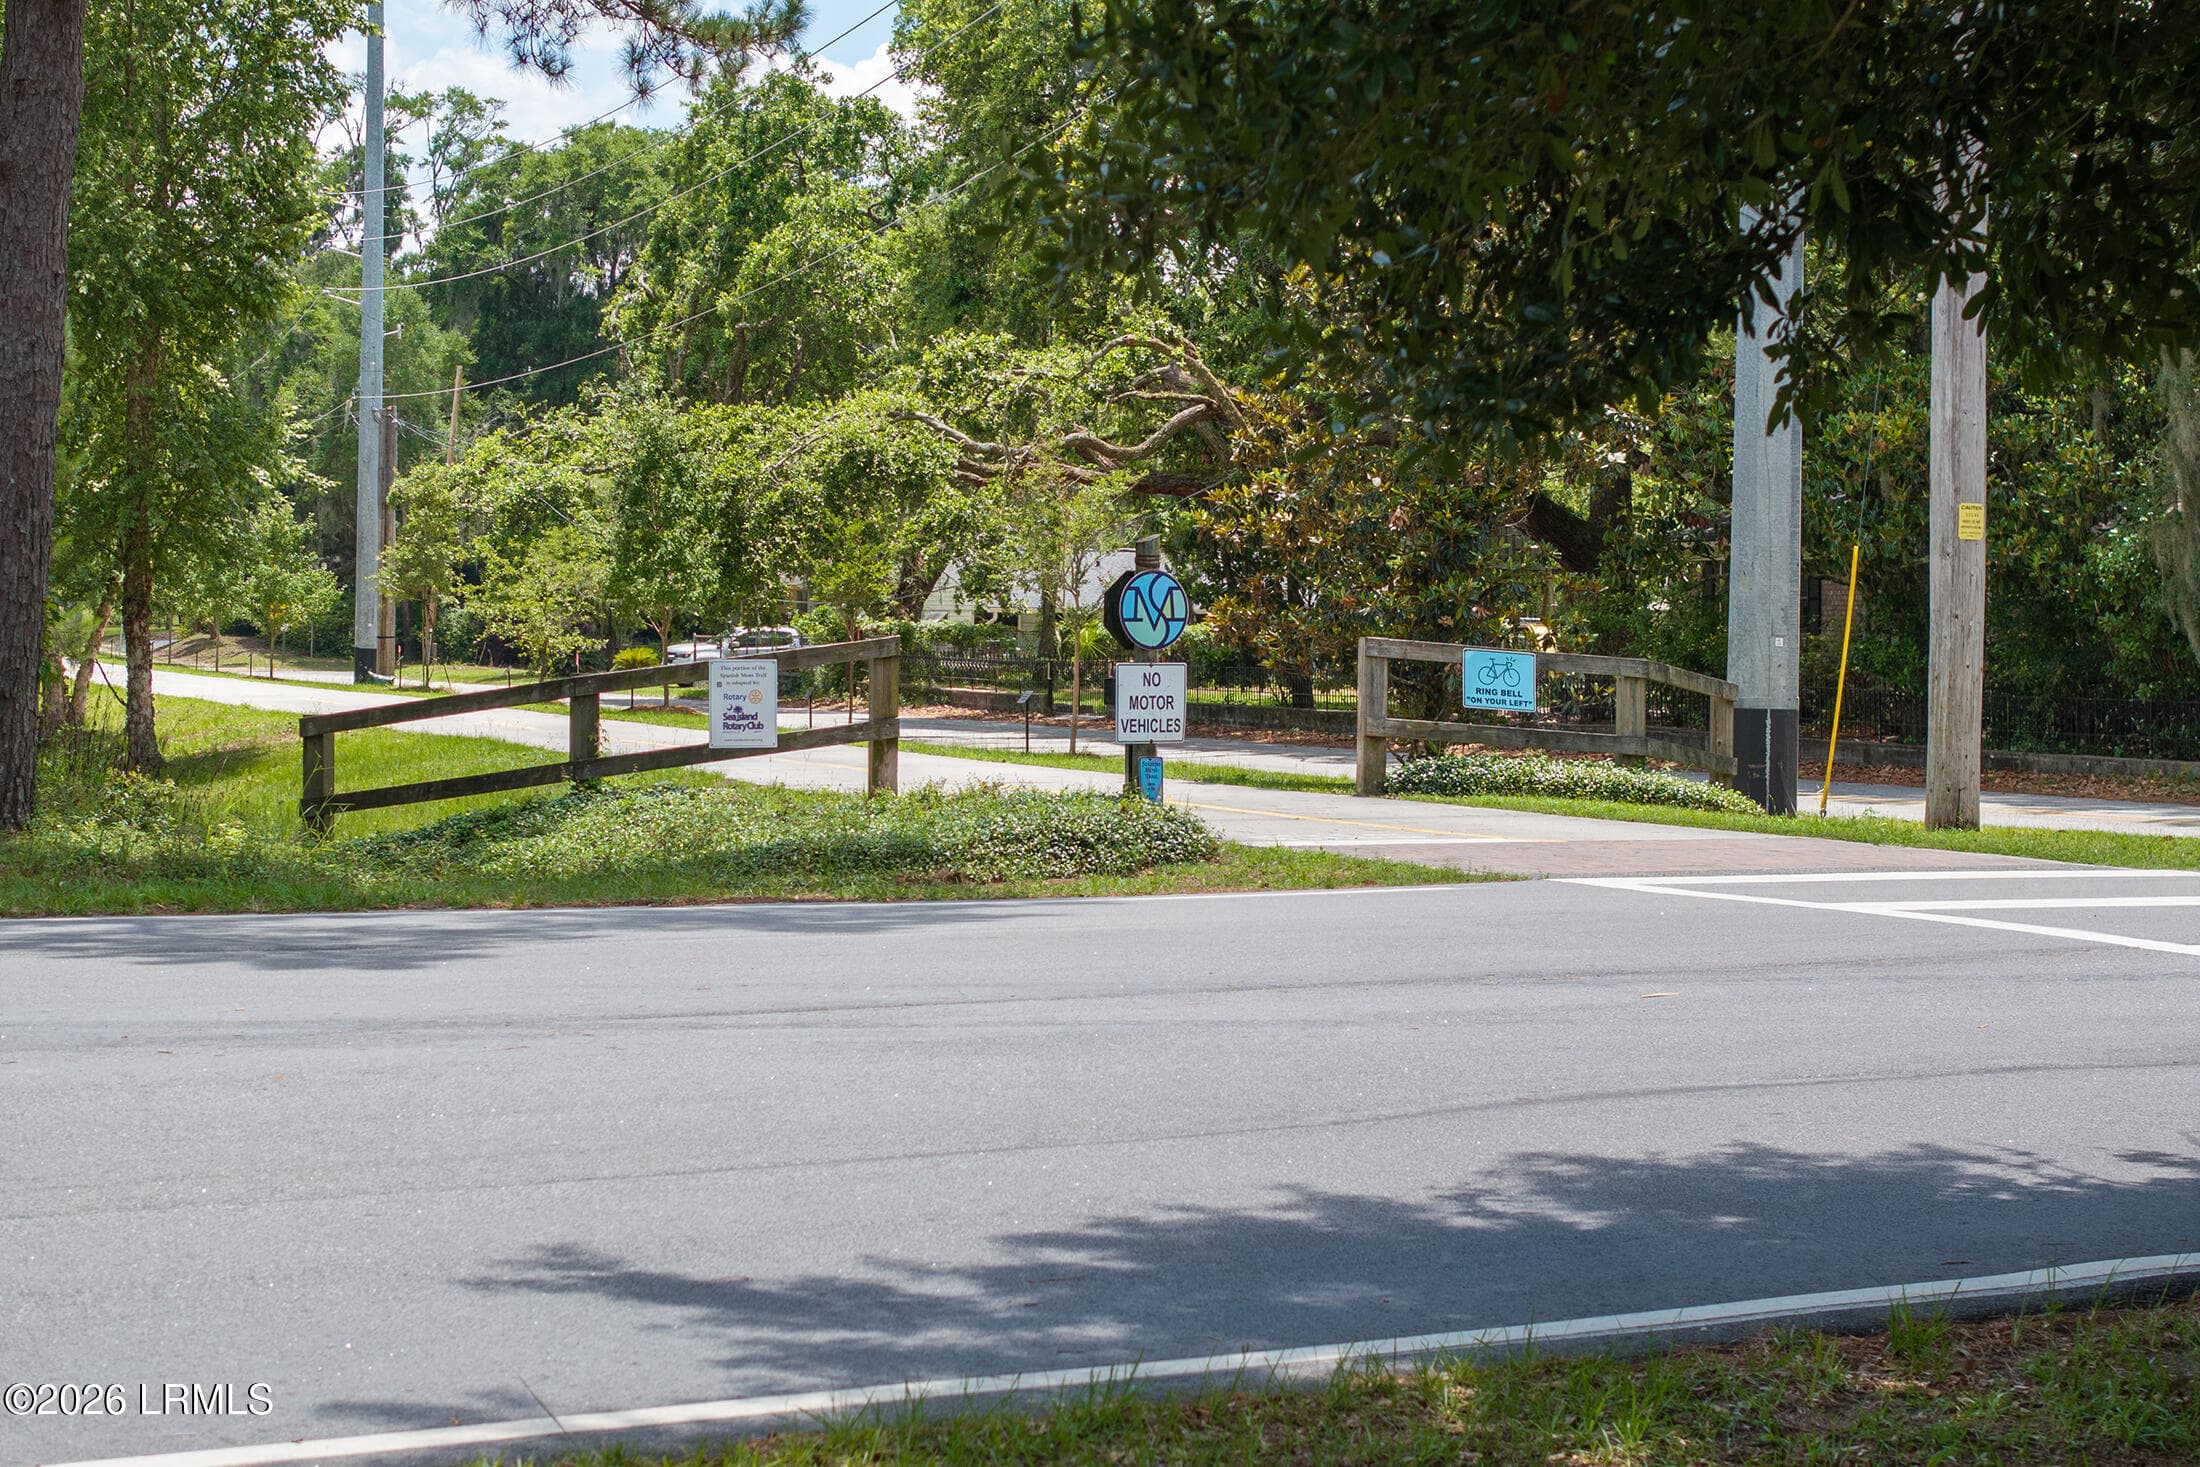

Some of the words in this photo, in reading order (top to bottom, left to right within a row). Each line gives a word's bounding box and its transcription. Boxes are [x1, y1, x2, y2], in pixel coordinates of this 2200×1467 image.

[1142, 672, 1161, 687] NO
[723, 693, 747, 701] Rotary
[1475, 687, 1498, 696] RING
[1500, 689, 1523, 698] BELL
[1129, 695, 1174, 710] MOTOR
[1466, 696, 1483, 704] "ON
[1485, 698, 1507, 706] YOUR
[723, 712, 736, 721] Sea
[736, 711, 758, 721] Island
[723, 722, 747, 732] Rotary
[747, 721, 764, 730] Club
[1120, 718, 1181, 733] VEHICLES
